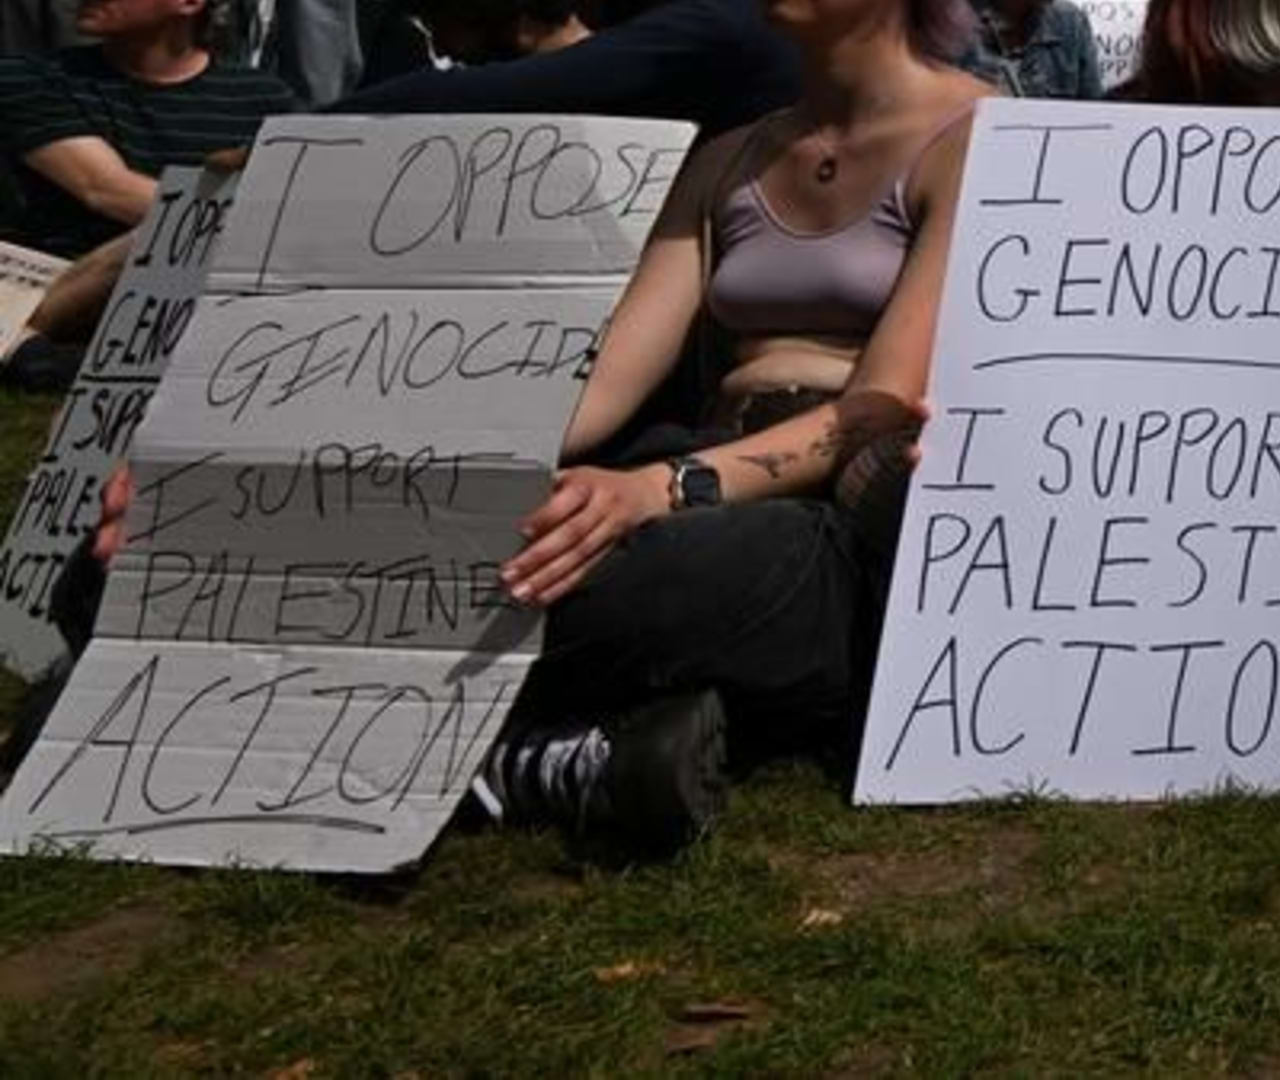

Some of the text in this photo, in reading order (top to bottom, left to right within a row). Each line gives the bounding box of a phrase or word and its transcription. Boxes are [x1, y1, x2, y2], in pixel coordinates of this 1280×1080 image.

[217, 123, 678, 304] I OPPOSE
[979, 123, 1113, 207] I
[135, 190, 183, 266] I
[207, 311, 599, 423] GENOCIDE
[42, 387, 88, 463] I
[921, 407, 1006, 491] I
[126, 441, 521, 542] I SUPPORT
[135, 550, 514, 647] PALESTINE
[29, 655, 507, 823] ACTION
